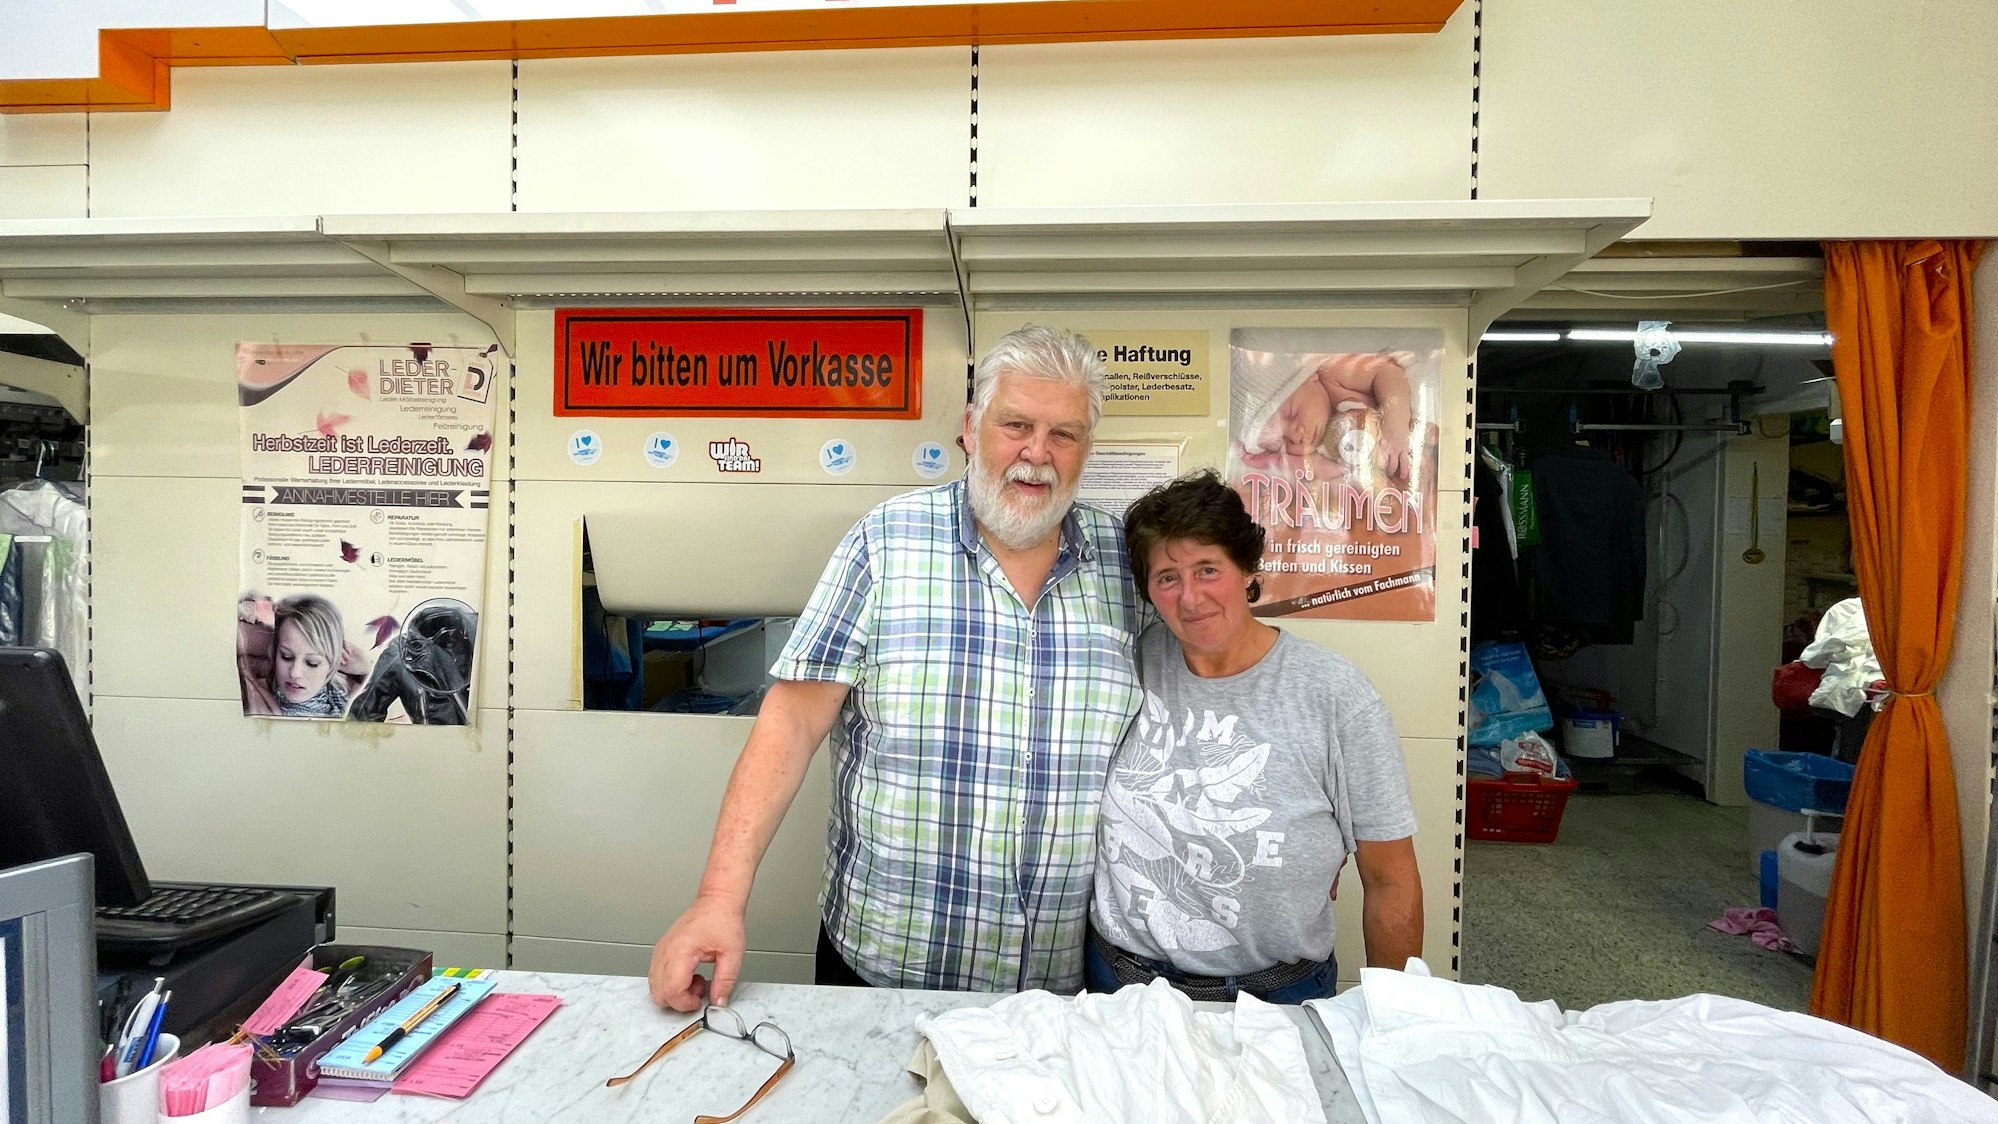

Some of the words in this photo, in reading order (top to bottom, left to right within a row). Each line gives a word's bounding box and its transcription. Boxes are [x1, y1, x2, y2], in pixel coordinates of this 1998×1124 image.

[580, 340, 622, 386] Wir
[632, 340, 707, 387] bitten
[718, 353, 757, 387] um
[768, 340, 893, 388] Vorkasse
[1114, 345, 1191, 366] Haftung
[380, 359, 457, 377] LEDER-
[1104, 372, 1131, 381] nallen,
[1133, 372, 1202, 381] Reißverschlüsse,
[380, 378, 454, 395] DIETER
[1110, 383, 1140, 392] polster,
[1142, 383, 1195, 391] Lederbesatz,
[1103, 393, 1150, 401] plikationen
[400, 405, 457, 414] Lederreinigung
[433, 422, 484, 432] Pelzreinigung
[252, 433, 338, 452] Herbstzeit
[341, 435, 363, 453] ist
[367, 435, 454, 455] Lederzeit.
[308, 455, 484, 477] LEDERREINIGUNG
[717, 459, 760, 472] TEAM!
[281, 488, 411, 506] ANNAHMESTELLE
[415, 491, 450, 506] HIER
[1241, 469, 1424, 534] TRÄUMEN
[1270, 541, 1283, 553] in
[1287, 539, 1321, 554] frisch
[1325, 542, 1400, 559] gereinigten
[1302, 559, 1326, 573] und
[1330, 559, 1372, 574] Kissen
[1311, 586, 1352, 606] natürlich
[1353, 584, 1373, 597] vom
[1374, 573, 1421, 592] Fachmann
